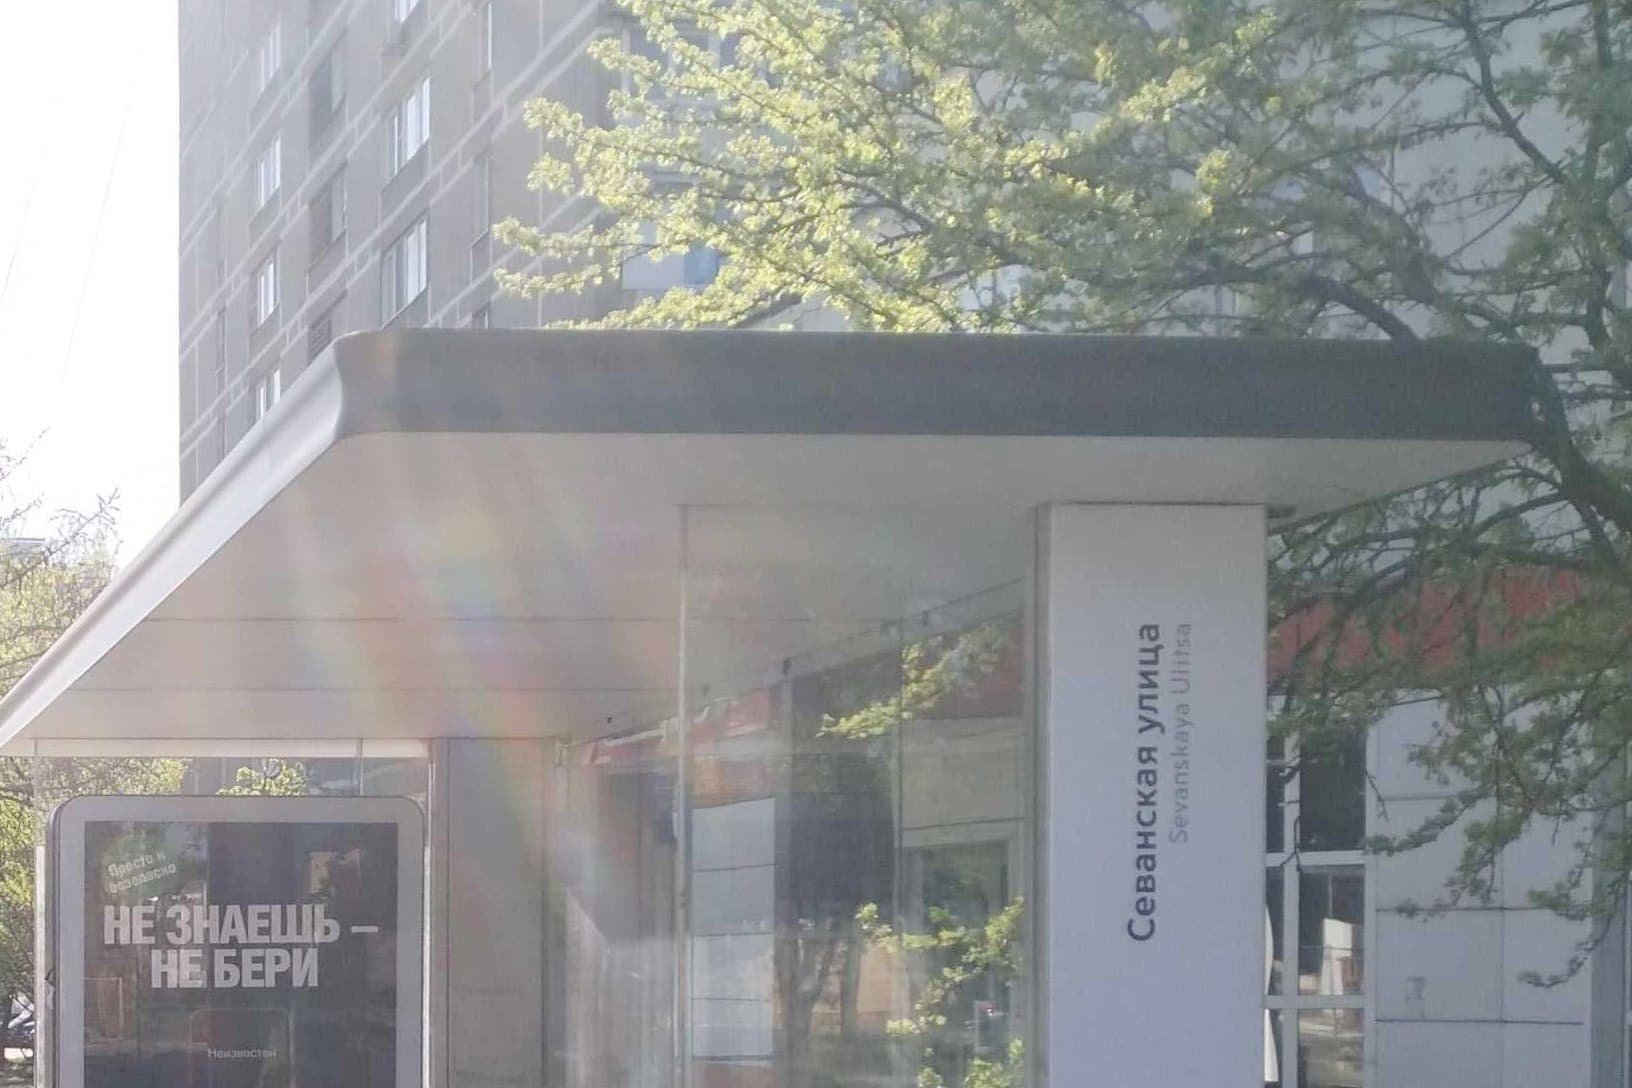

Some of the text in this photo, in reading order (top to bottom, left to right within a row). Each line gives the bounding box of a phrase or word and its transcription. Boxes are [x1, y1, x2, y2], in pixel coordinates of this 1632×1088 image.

[1127, 623, 1166, 942] Севанская улица
[1169, 623, 1194, 844] Sevanskaya Ulitsa
[103, 904, 155, 945] НЕ
[166, 903, 341, 945] ЗНАЕШЬ
[150, 948, 319, 989] НЕ БЕРИ
